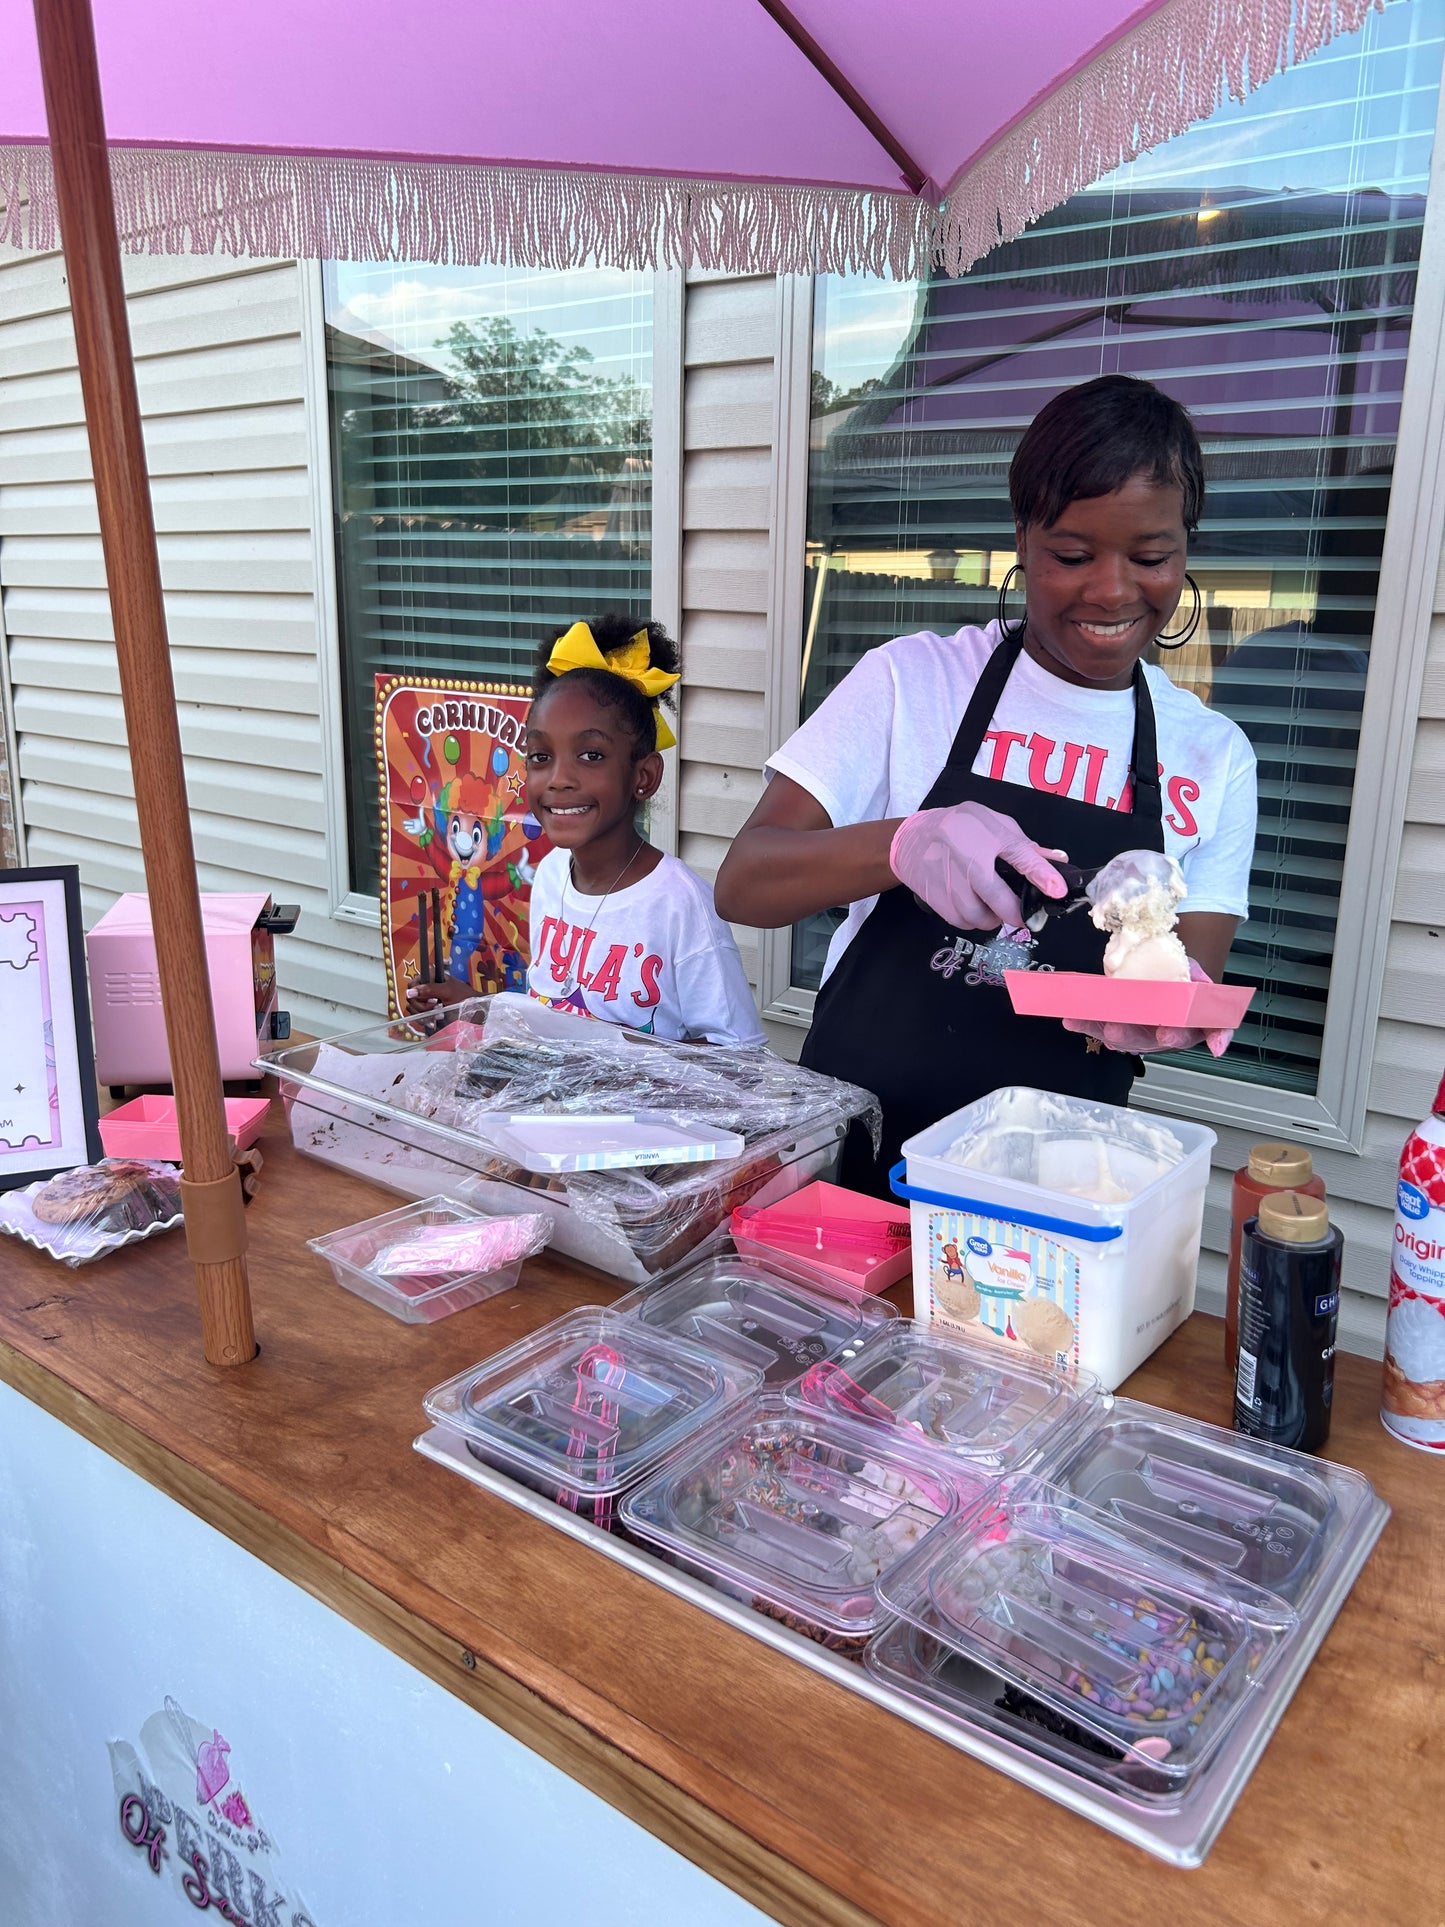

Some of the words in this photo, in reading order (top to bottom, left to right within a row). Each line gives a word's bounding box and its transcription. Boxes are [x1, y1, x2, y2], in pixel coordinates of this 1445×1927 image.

[534, 915, 664, 1008] TYLA'S
[1398, 1184, 1422, 1209] Great
[1401, 1199, 1421, 1215] Value
[969, 1238, 988, 1250] Great
[987, 1260, 1027, 1283] Vanilla
[1400, 1254, 1417, 1270] Dairy
[1409, 1267, 1444, 1288] Topping
[120, 1794, 170, 1875] Of
